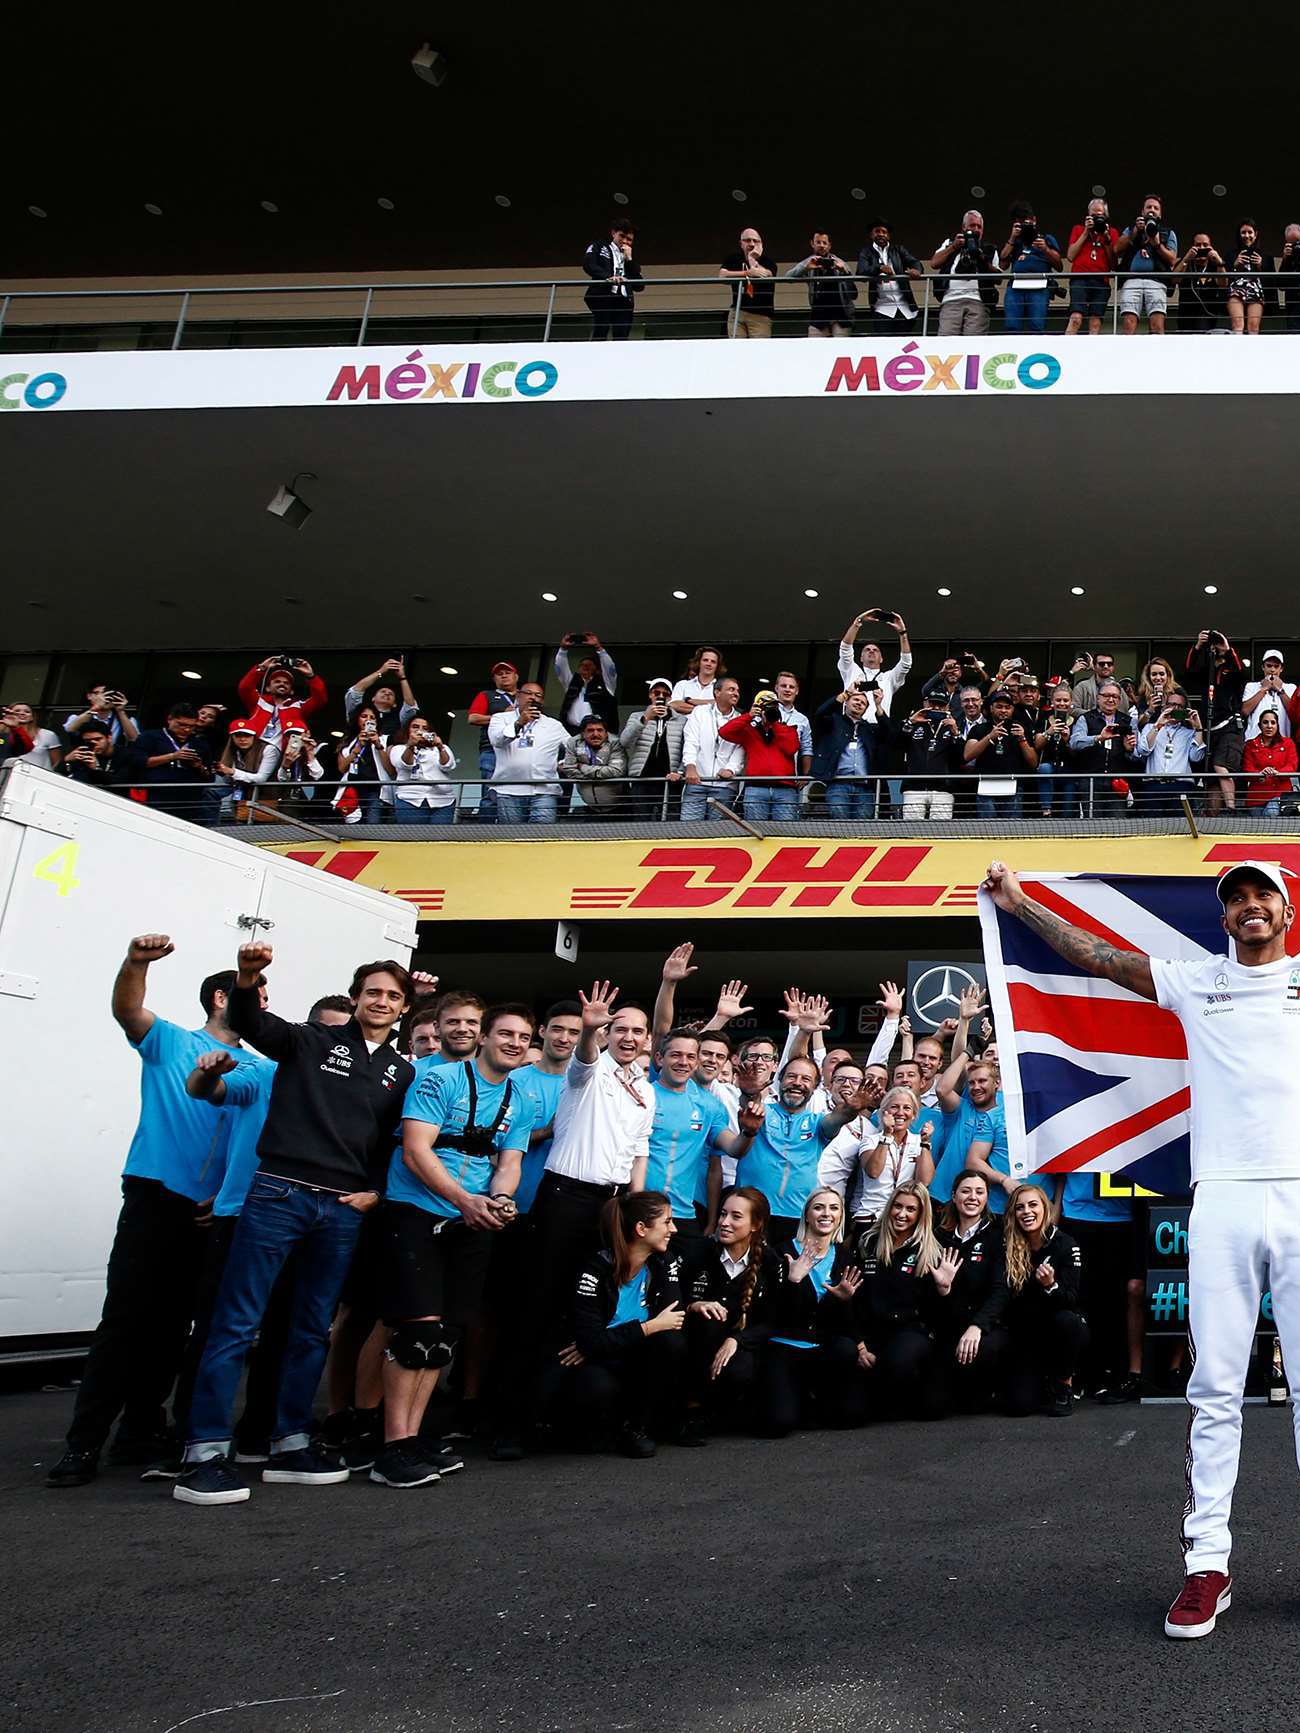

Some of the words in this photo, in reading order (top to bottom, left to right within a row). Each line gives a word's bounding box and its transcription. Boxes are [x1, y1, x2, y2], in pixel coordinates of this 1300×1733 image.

[32, 842, 81, 896] 4
[630, 846, 947, 909] DHL
[563, 930, 572, 950] 6
[1215, 994, 1232, 1003] UBS
[336, 1058, 352, 1069] UBS
